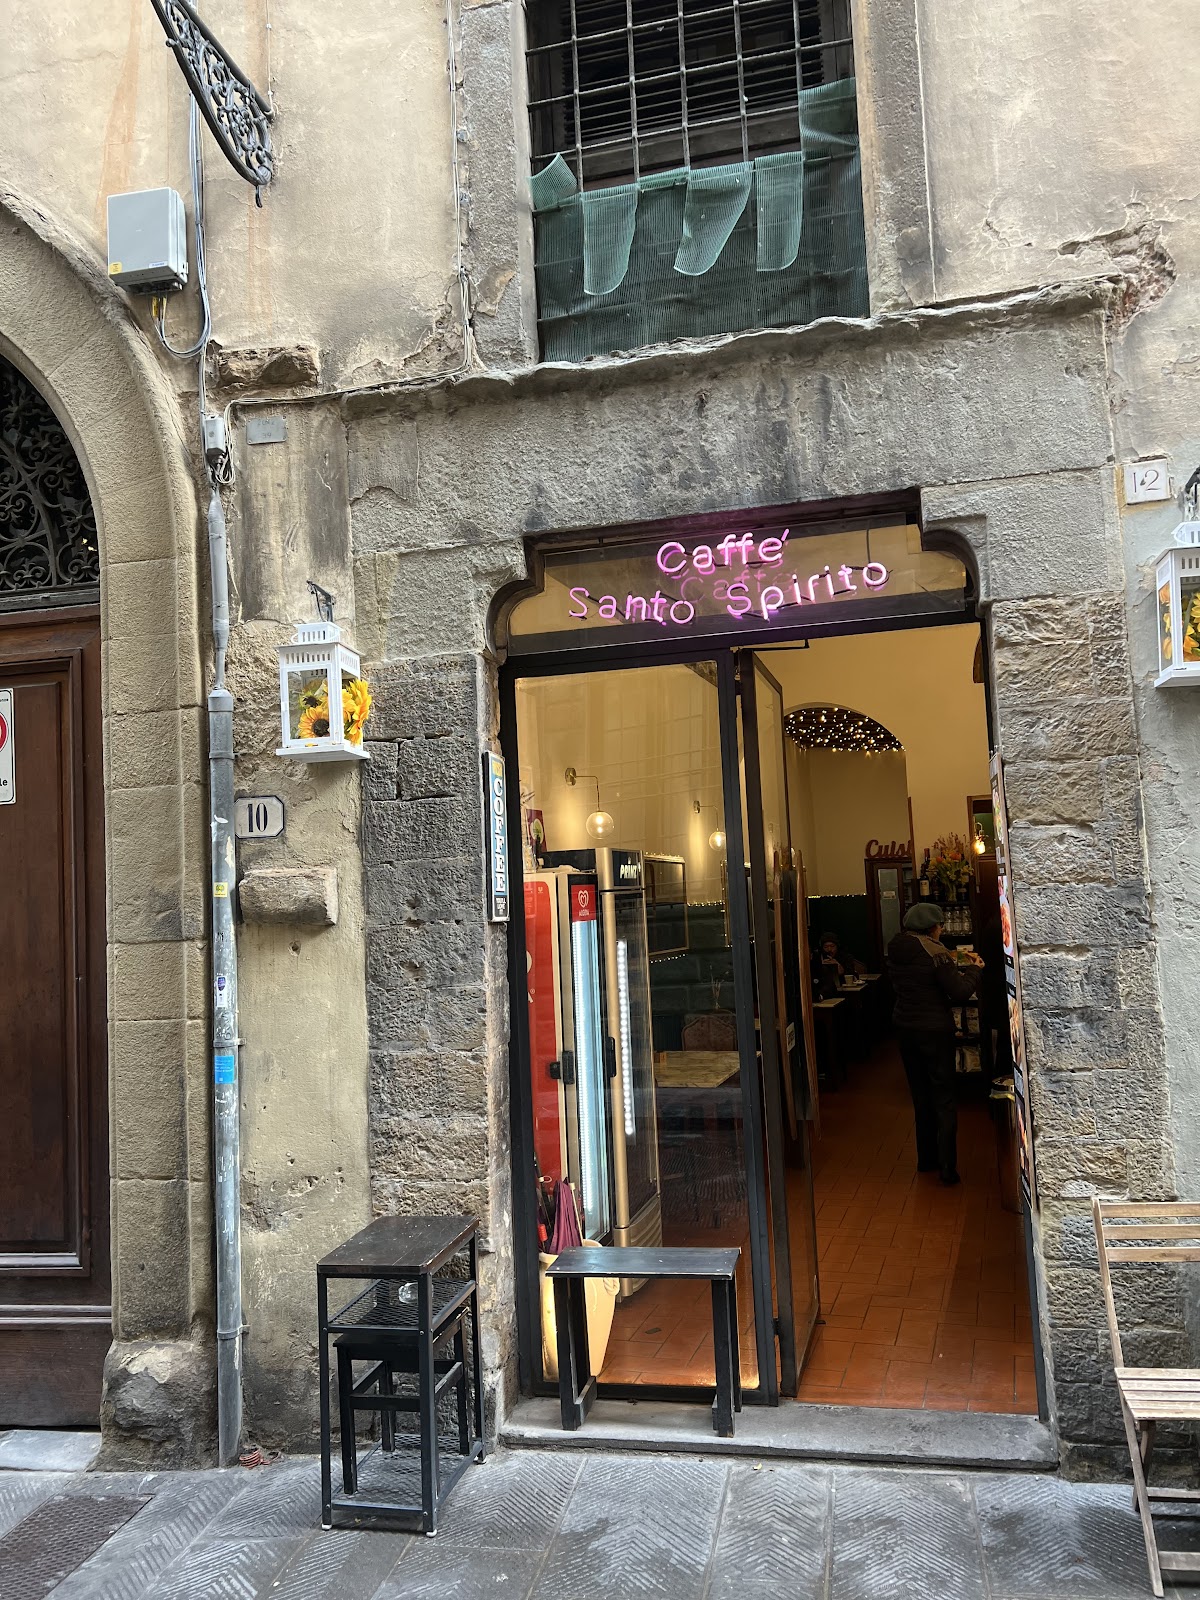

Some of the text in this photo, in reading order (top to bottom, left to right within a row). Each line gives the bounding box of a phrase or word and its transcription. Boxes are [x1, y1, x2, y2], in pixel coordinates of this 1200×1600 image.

[1132, 469, 1161, 493] 12
[569, 561, 888, 624] Santo Spirito
[247, 802, 268, 832] 10
[493, 778, 505, 892] COFFEE
